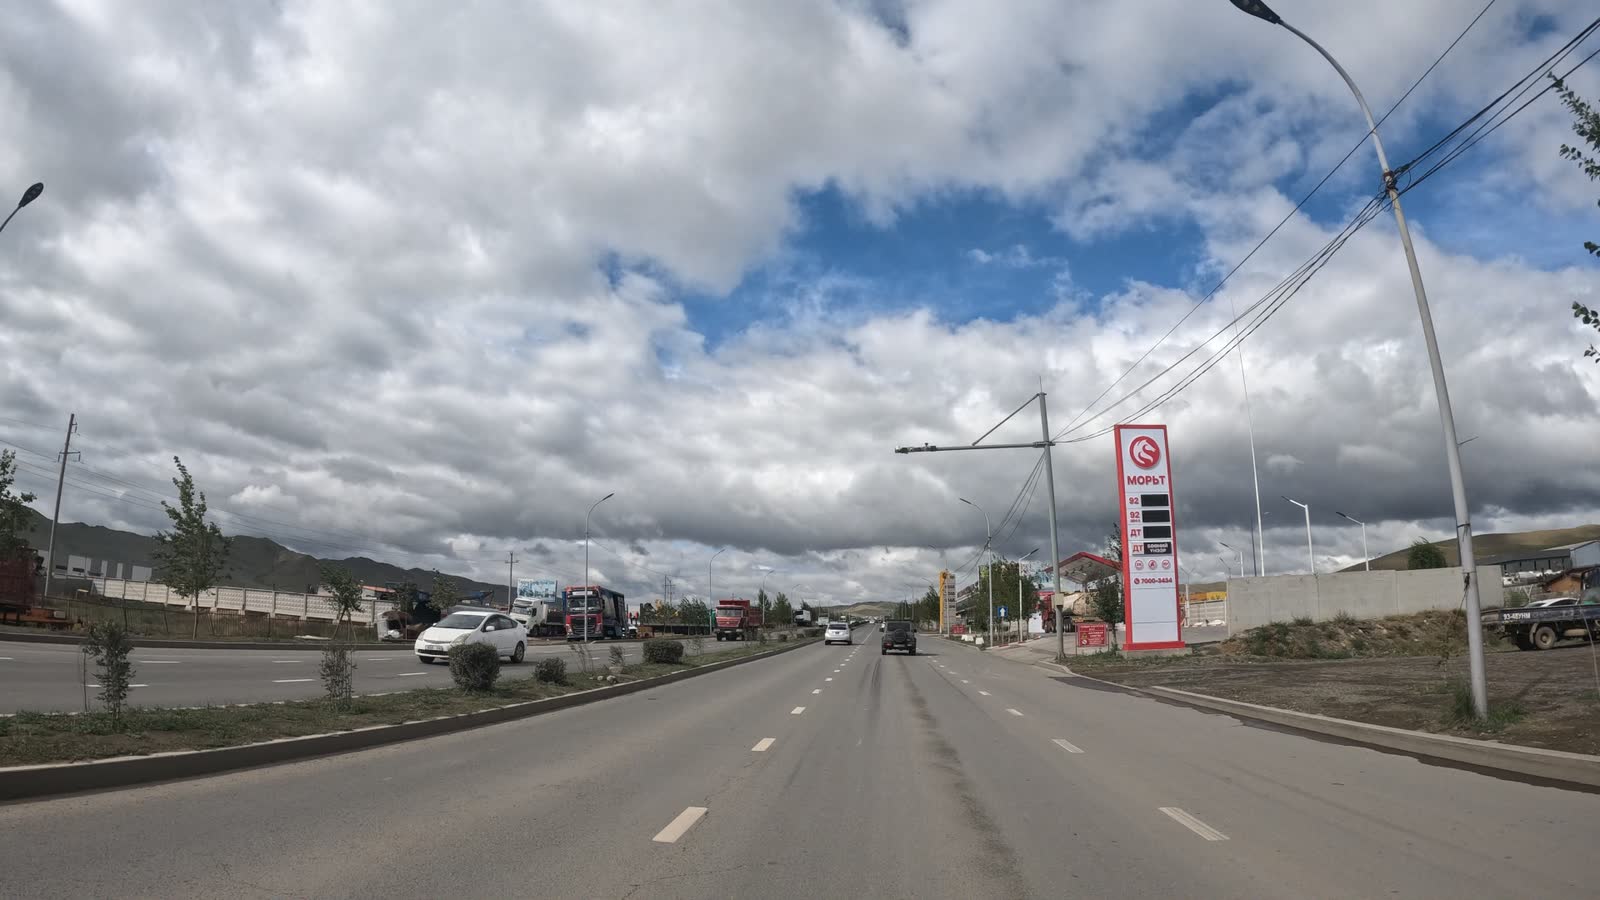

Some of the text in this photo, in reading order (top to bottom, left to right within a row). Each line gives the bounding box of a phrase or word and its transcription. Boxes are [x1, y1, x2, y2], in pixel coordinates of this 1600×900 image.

[1127, 475, 1165, 485] МОРЬТ
[1130, 529, 1141, 537] ДТ
[1132, 544, 1143, 552] ДТ
